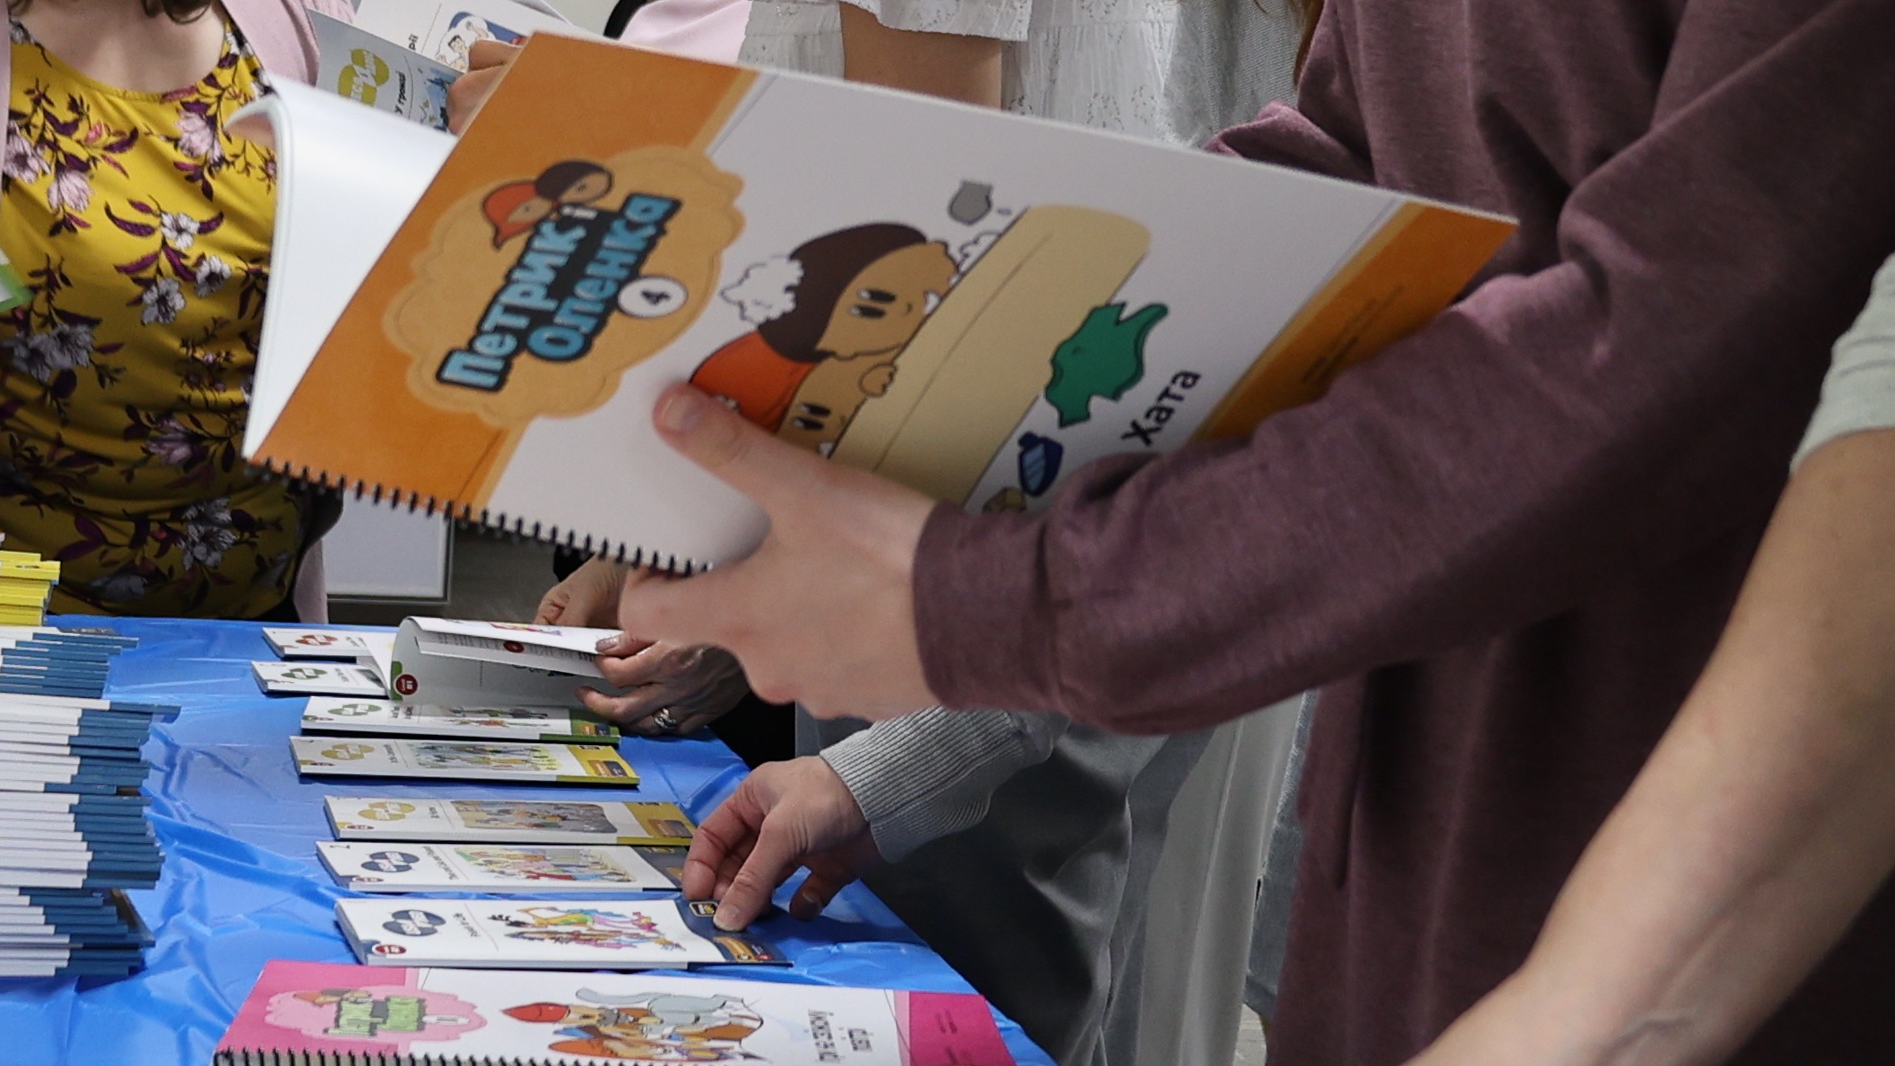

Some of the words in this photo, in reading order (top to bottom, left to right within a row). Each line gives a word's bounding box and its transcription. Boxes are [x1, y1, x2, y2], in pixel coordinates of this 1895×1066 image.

[438, 218, 588, 389] Петрик
[525, 193, 677, 360] Оленка
[639, 288, 674, 307] 4
[1120, 368, 1202, 447] Хата
